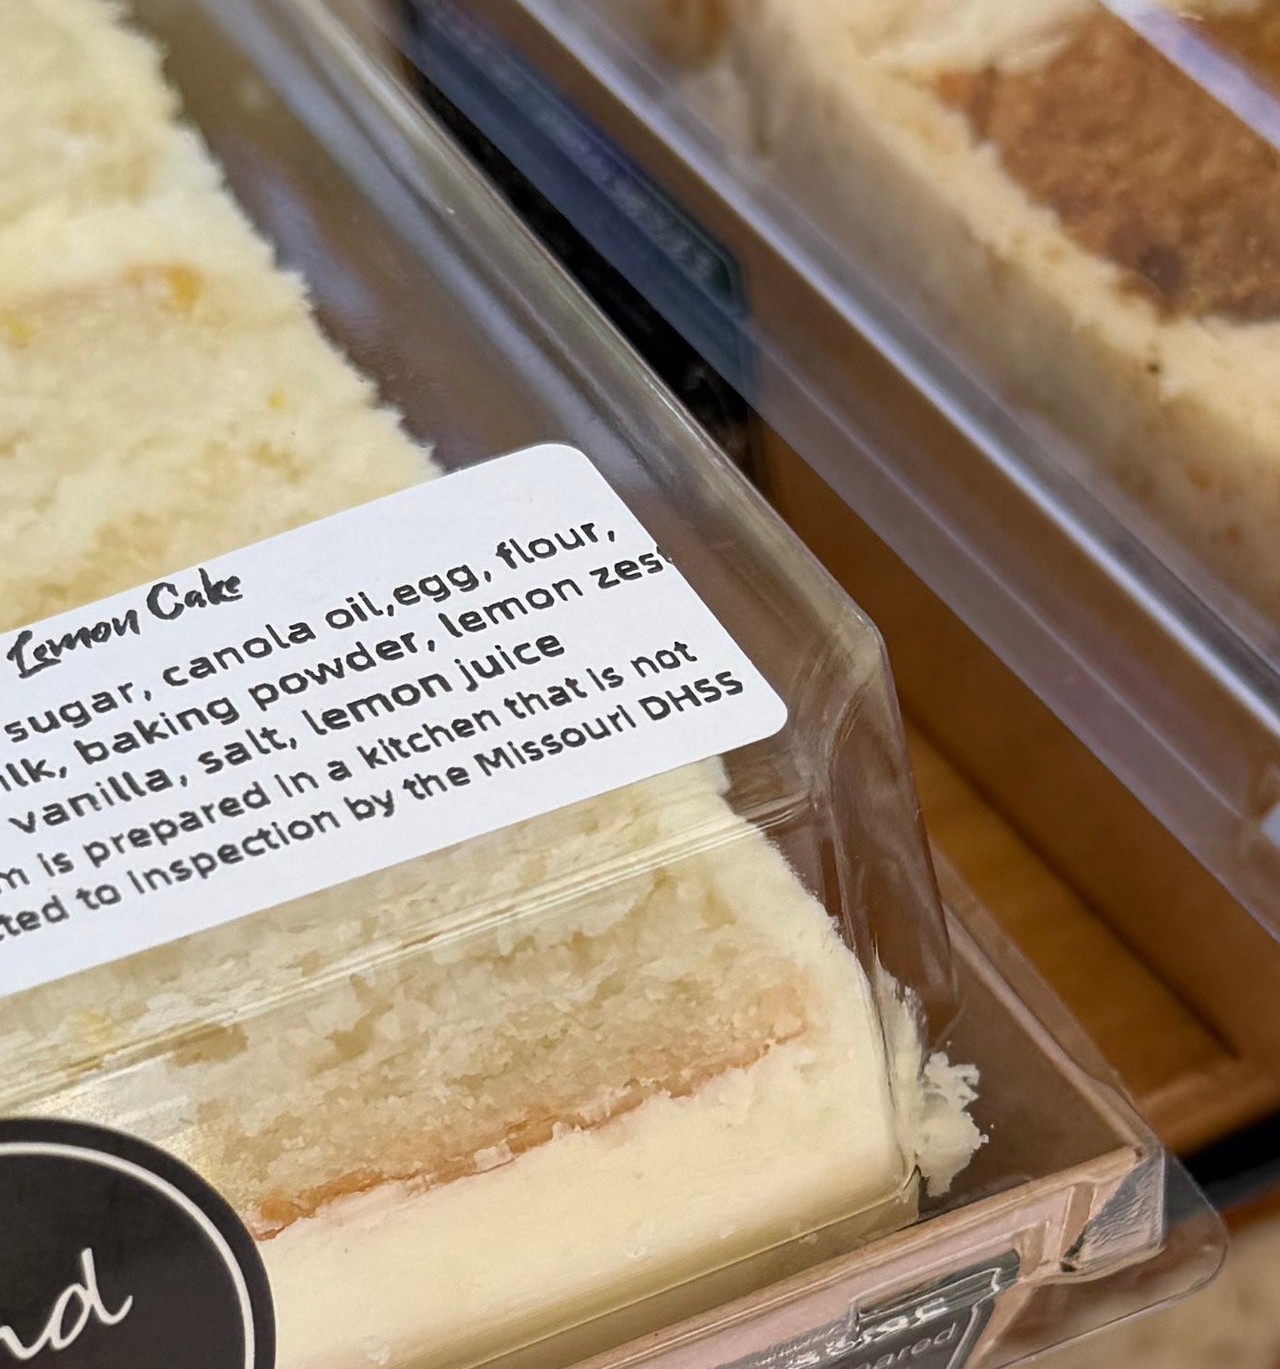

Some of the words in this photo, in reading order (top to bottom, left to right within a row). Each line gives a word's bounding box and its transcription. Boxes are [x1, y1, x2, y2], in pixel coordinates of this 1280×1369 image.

[3, 681, 152, 744] sugar,
[161, 621, 317, 688] canola
[494, 521, 616, 571] flour,
[5, 608, 141, 680] Lemon
[145, 567, 244, 621] Cake
[7, 767, 188, 835] vanilla,
[196, 725, 298, 775] salt,
[300, 672, 454, 737] lemon
[453, 633, 566, 693] juice
[72, 696, 241, 766] baking
[247, 630, 436, 713] powder,
[436, 577, 585, 639] lemon
[588, 545, 673, 590] zes
[36, 851, 75, 878] is
[82, 780, 272, 869] prepared
[273, 770, 320, 799] in
[326, 759, 354, 783] a
[355, 708, 502, 770] kitchen
[502, 676, 589, 720] that
[585, 666, 625, 692] is
[629, 640, 699, 679] not
[75, 883, 122, 911] to
[125, 810, 342, 895] inspection
[342, 788, 395, 822] by
[401, 765, 472, 801] the
[472, 703, 638, 778] Missouri
[637, 670, 745, 722] DHSS
